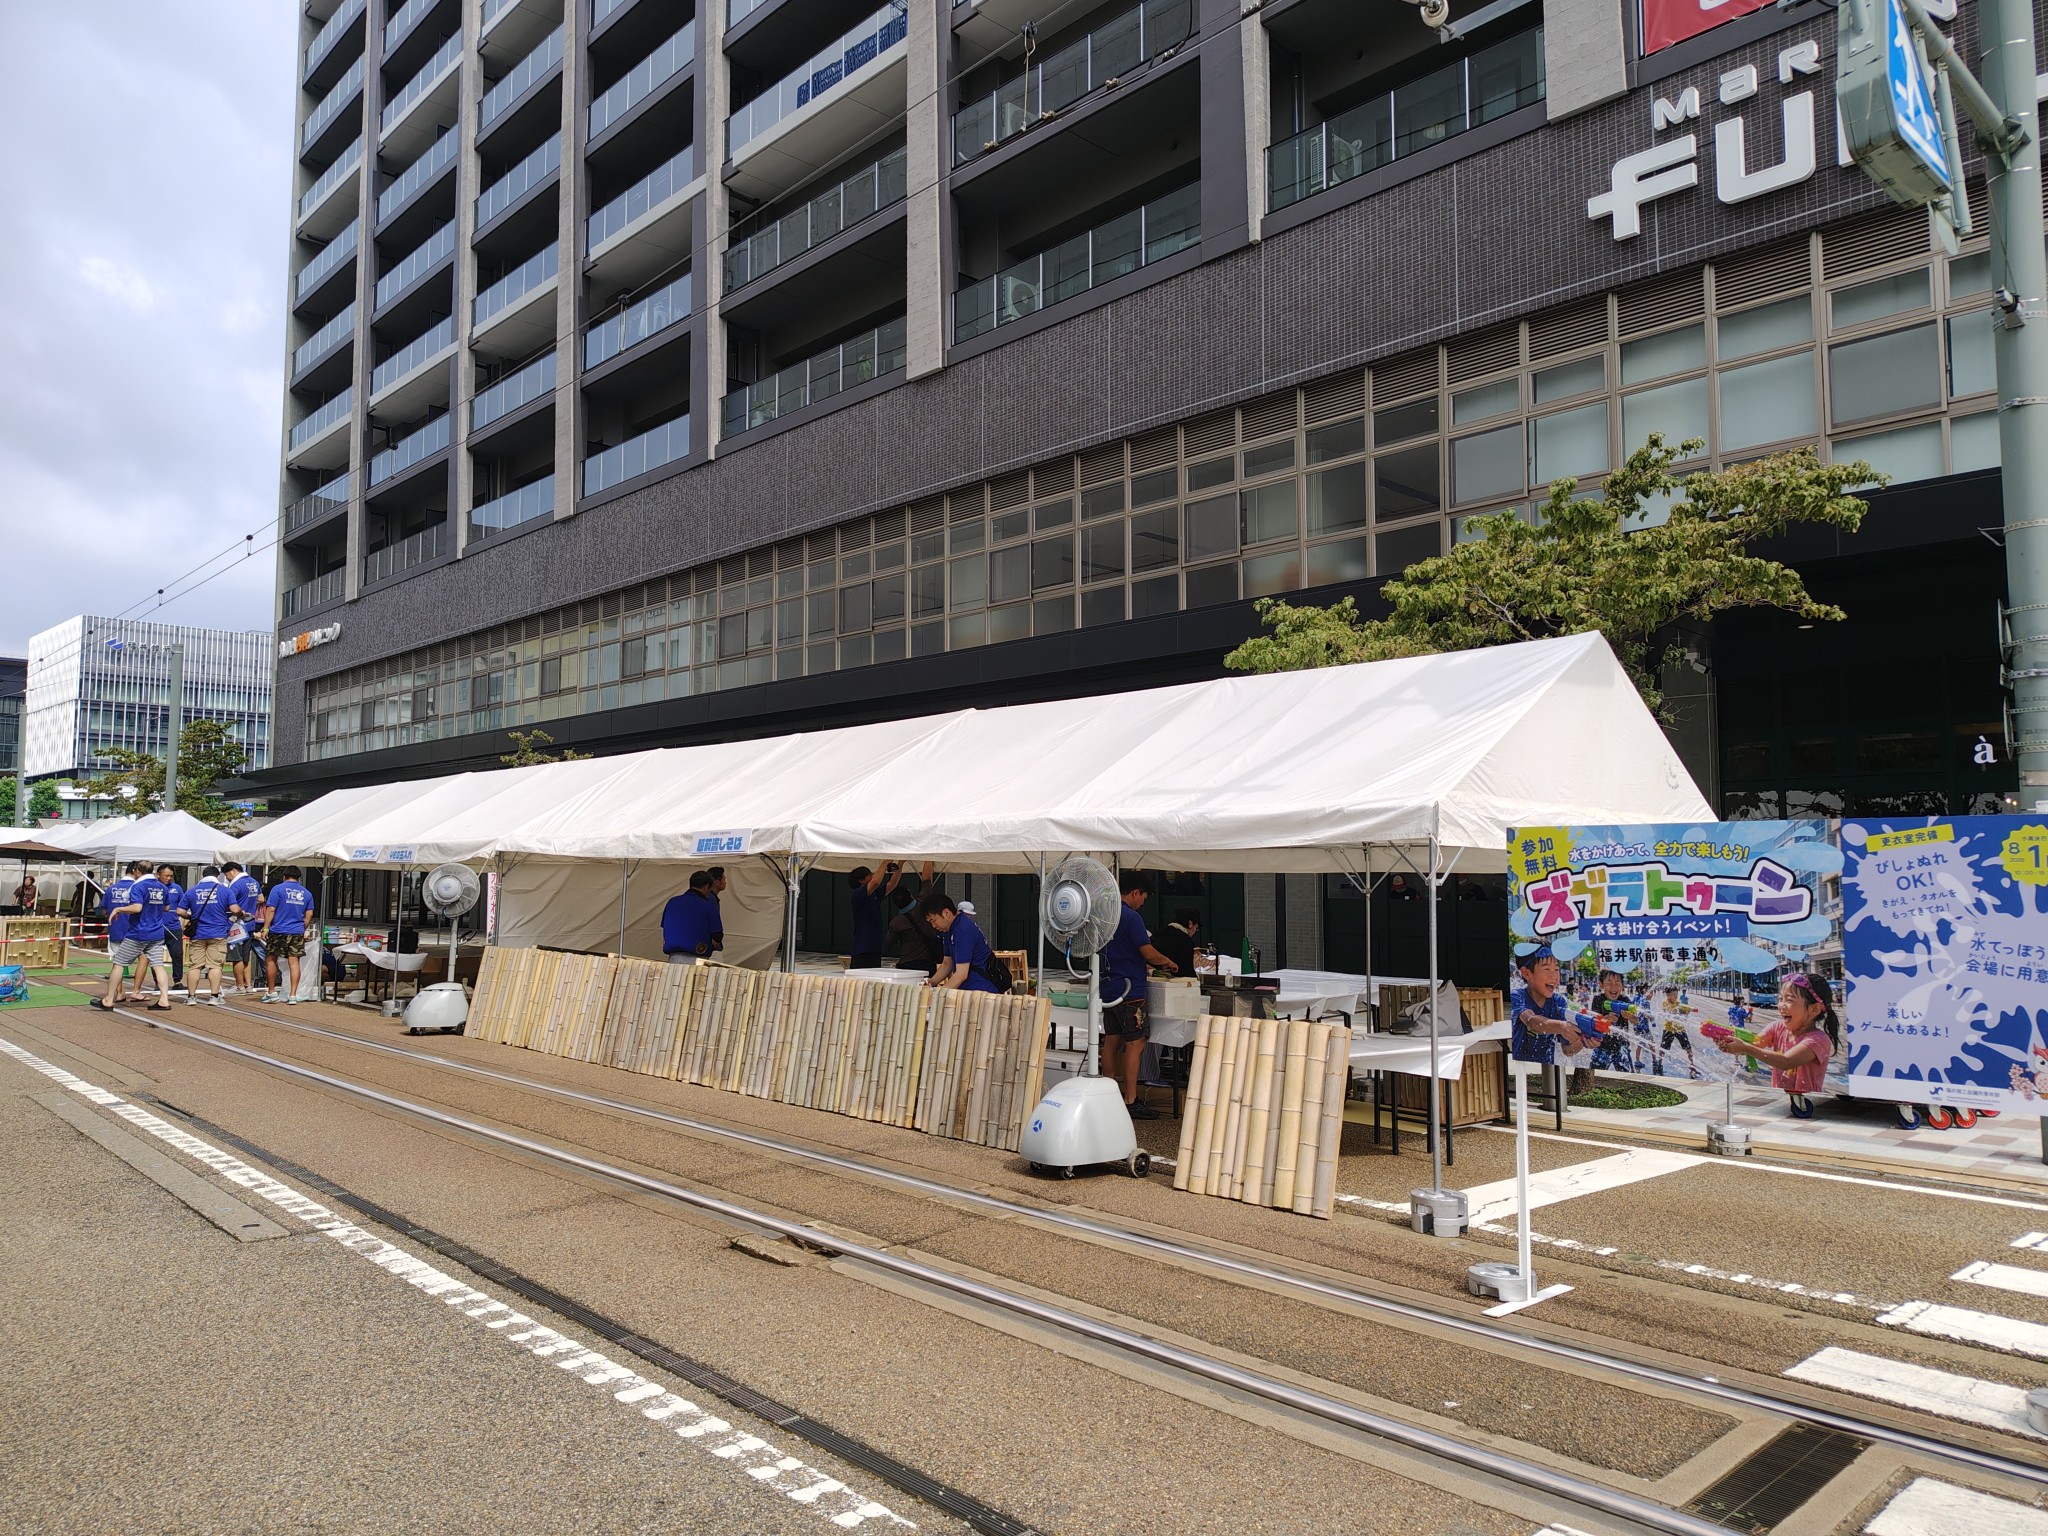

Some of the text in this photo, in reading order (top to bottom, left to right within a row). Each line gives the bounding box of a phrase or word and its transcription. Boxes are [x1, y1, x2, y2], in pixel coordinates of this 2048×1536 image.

[1520, 836, 1554, 856] 参加
[1880, 829, 1938, 848] 更衣室完備
[1568, 842, 1650, 863] 水をかけあって、
[2009, 842, 2048, 868] 8 1
[1524, 854, 1558, 876] 無料
[1875, 851, 1948, 875] びしょぬれ
[1896, 871, 1935, 891] OK!
[1529, 864, 1808, 931] ズブラトゥーン
[1591, 917, 1731, 937] 水を掛け合うイベント!
[1598, 946, 1719, 964] 福井駅前電車通り
[1970, 937, 2046, 961] 水てっぽう
[1965, 958, 2048, 984] 会場に用意
[1887, 1007, 1923, 1020] 楽しい
[1861, 1020, 1950, 1038] ゲームもあるよ!
